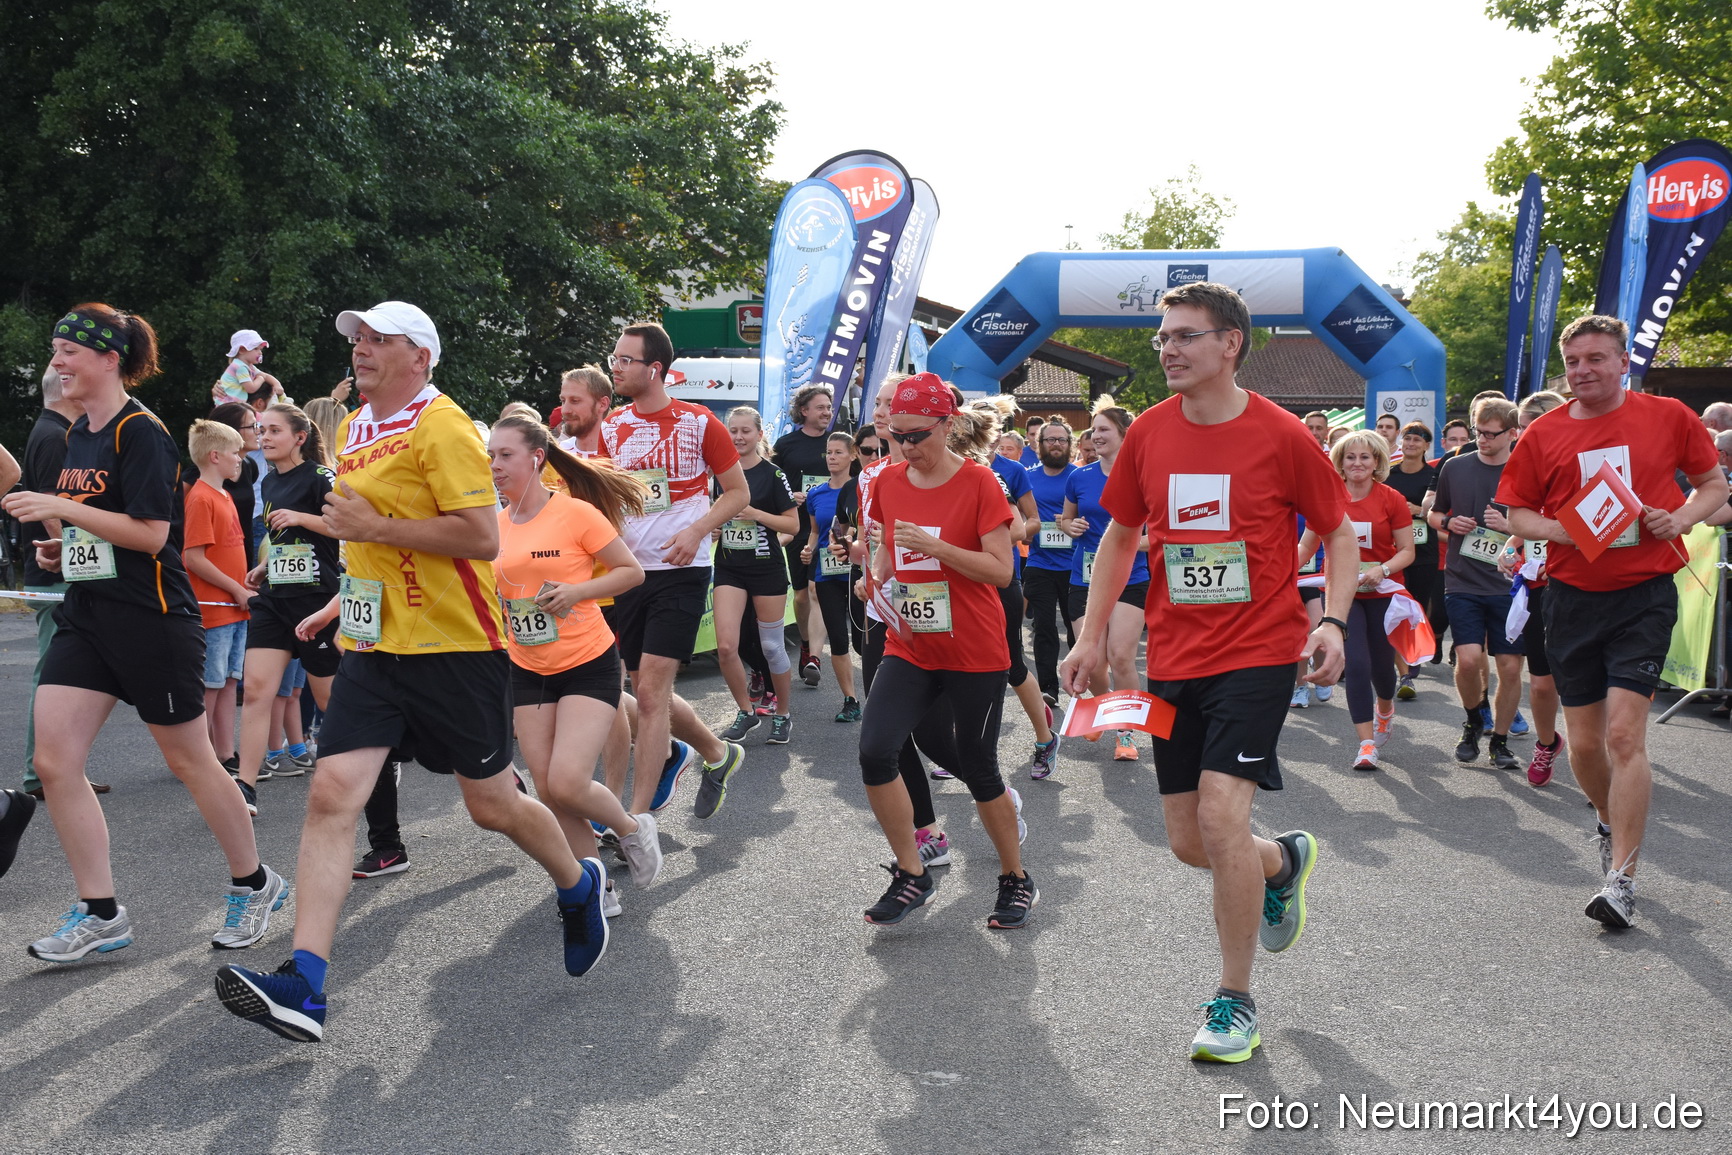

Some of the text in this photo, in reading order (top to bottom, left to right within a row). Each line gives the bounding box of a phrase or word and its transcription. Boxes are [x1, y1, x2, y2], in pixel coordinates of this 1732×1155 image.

[845, 177, 897, 209] ervis
[1647, 173, 1723, 207] Hervis
[1655, 202, 1685, 213] SPORTS
[892, 204, 921, 285] Fischer
[904, 211, 926, 280] AUTOMOBILE
[1175, 272, 1206, 281] Fischer
[981, 320, 1029, 331] Fischer
[1353, 316, 1366, 324] das
[367, 438, 410, 464] BÖGL
[56, 468, 109, 493] WINGS
[1189, 506, 1209, 517] DEHN
[1597, 511, 1629, 543] DEHN protects.
[724, 529, 753, 541] 1743
[1046, 533, 1065, 542] 9111
[1471, 538, 1498, 555] 419
[68, 544, 99, 565] 284
[531, 550, 560, 559] THULE
[824, 557, 850, 567] 11
[911, 552, 924, 560] DEHN
[272, 558, 306, 573] 1756
[1183, 565, 1228, 588] 537
[1172, 587, 1225, 595] Schimmelschmidt
[341, 597, 372, 624] 1703
[900, 600, 935, 619] 465
[511, 613, 548, 633] 318
[522, 630, 547, 639] Katharina
[1131, 694, 1153, 703] DEHN
